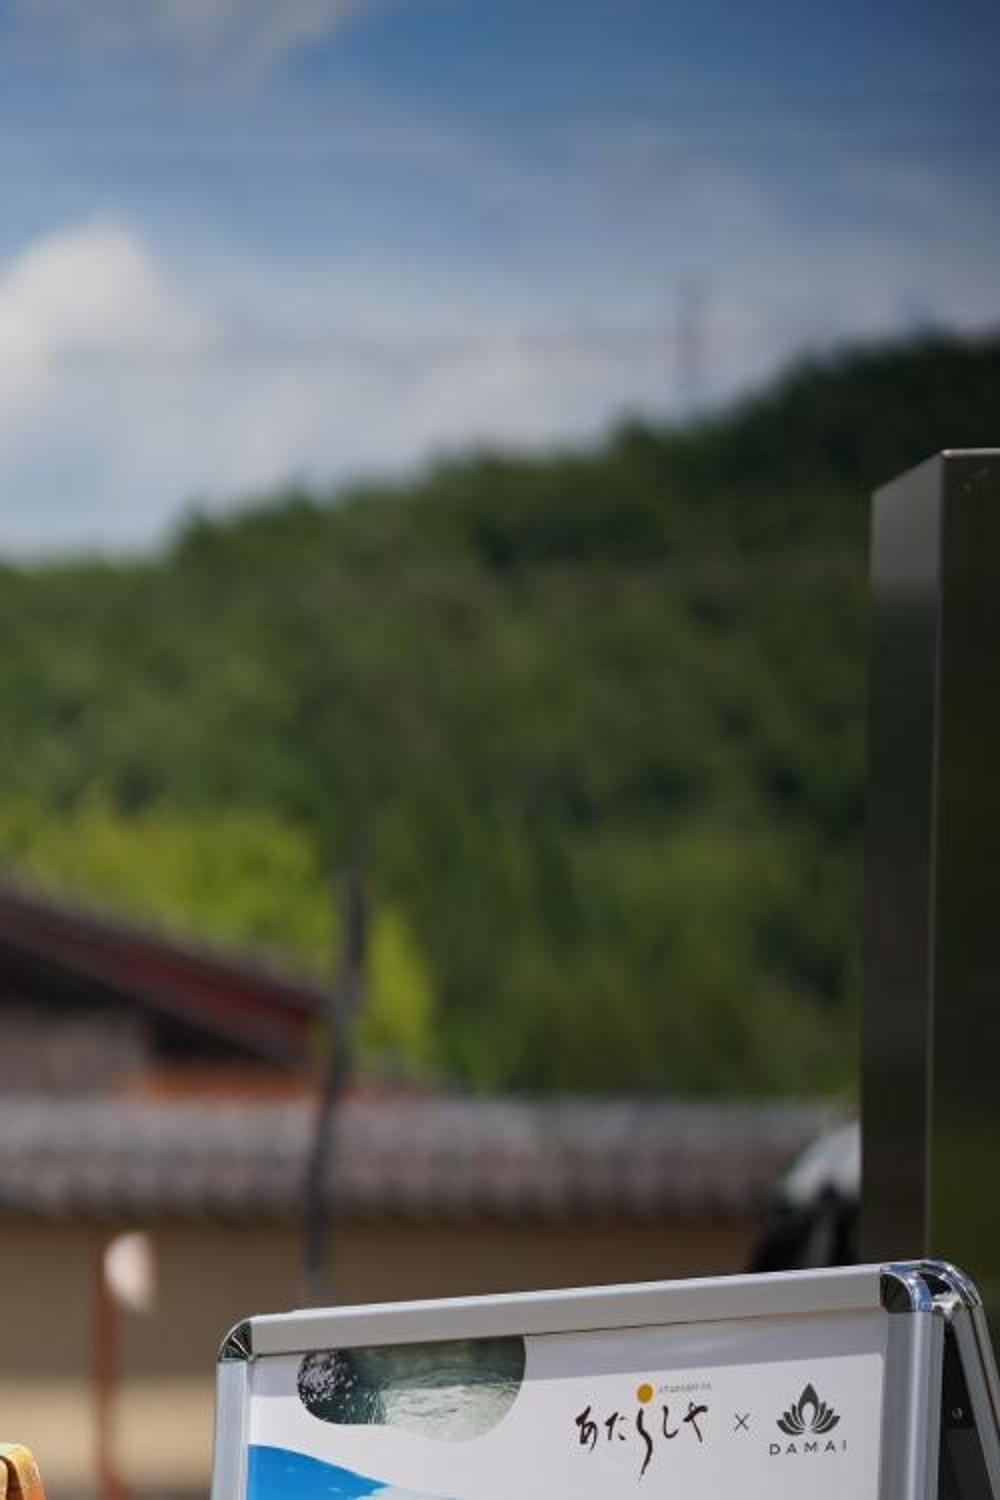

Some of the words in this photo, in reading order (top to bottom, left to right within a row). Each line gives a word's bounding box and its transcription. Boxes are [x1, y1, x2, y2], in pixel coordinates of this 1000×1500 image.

[575, 1402, 708, 1482] あたらしや
[769, 1440, 847, 1456] DAMAI
